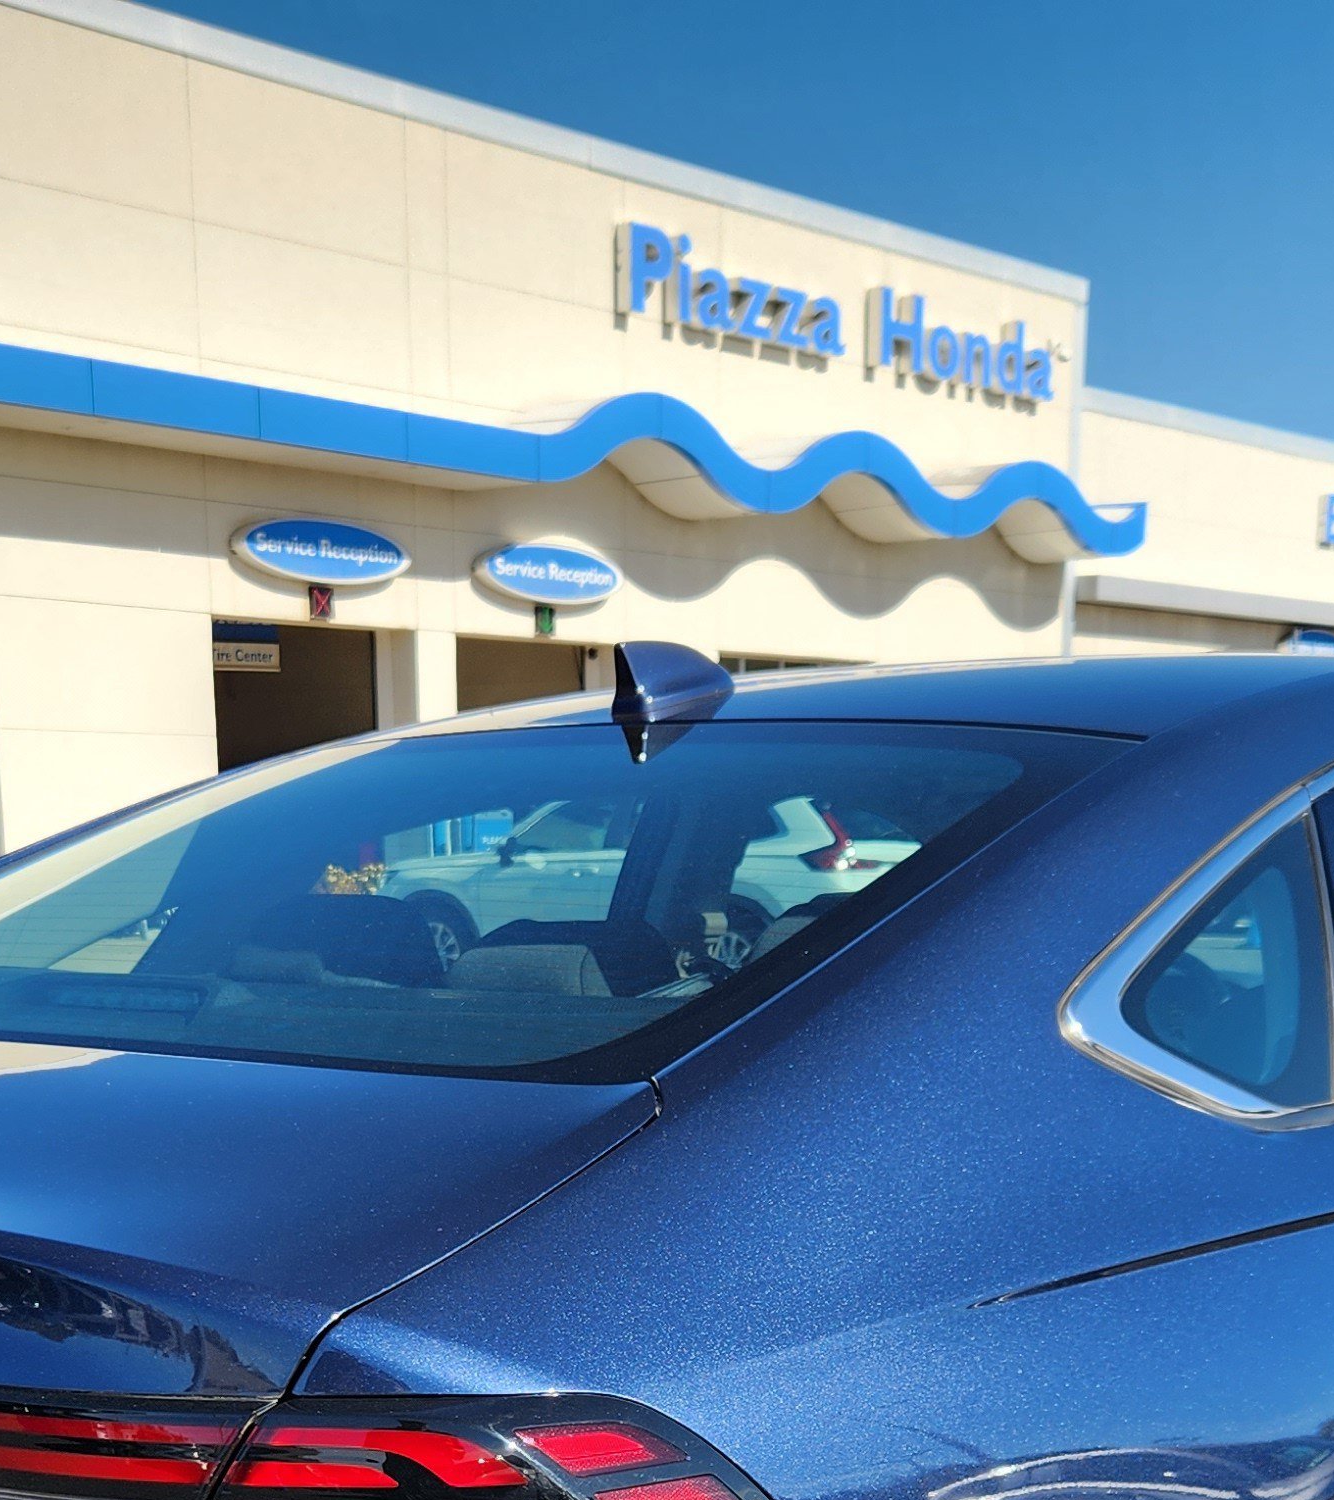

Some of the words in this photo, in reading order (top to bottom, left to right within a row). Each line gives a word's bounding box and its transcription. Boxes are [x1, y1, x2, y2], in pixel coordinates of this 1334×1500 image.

[625, 221, 845, 356] Piazza
[876, 286, 1054, 401] Honda
[255, 532, 317, 557] Service
[320, 539, 399, 567] Reception
[494, 555, 546, 580] Service
[548, 562, 614, 588] Reception
[235, 649, 273, 663] Center
